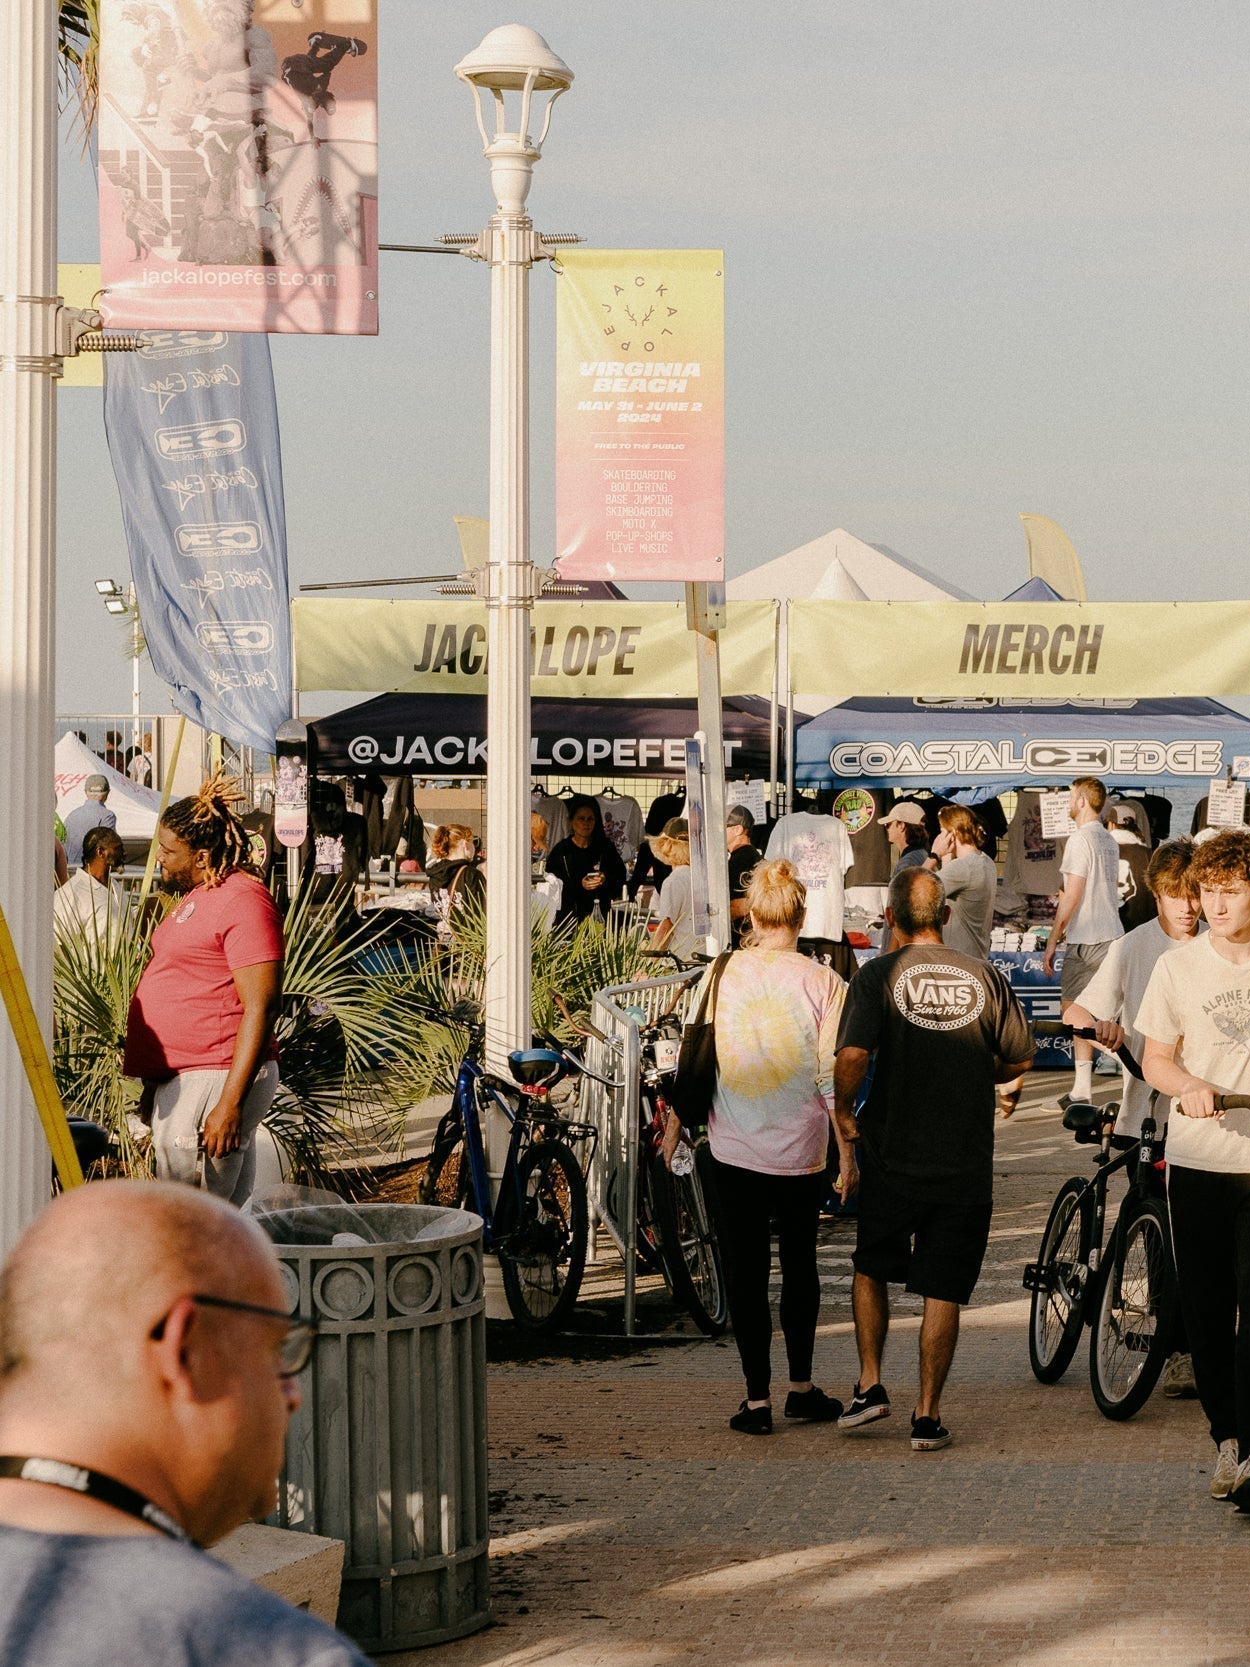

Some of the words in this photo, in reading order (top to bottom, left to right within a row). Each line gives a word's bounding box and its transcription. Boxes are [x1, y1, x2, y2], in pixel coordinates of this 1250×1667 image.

[139, 268, 337, 287] jackalopefest.com
[579, 361, 702, 377] VIRGINIA
[592, 378, 687, 393] BEACH
[578, 401, 612, 411] MAY
[616, 401, 633, 411] 31
[646, 401, 690, 411] JUNE
[691, 401, 703, 411] 2
[617, 413, 662, 423] 2024
[602, 469, 676, 480] SKATEBOARDING
[611, 482, 668, 492] BOULDERING
[605, 495, 628, 505] BASE
[633, 495, 673, 505] JUMPING
[605, 507, 673, 517] SKIMBOARDING
[622, 519, 646, 529] MOTO
[646, 519, 657, 529] X
[605, 531, 674, 541] POP-UP-SHOPS
[611, 543, 635, 553] LIVE
[639, 543, 669, 554] MUSIC
[413, 623, 642, 676] JACLOPE
[958, 623, 1105, 675] MERCH
[347, 735, 743, 767] @JACKLOPEFET
[829, 739, 1027, 777] COASTAL
[1110, 740, 1224, 777] EDGE
[906, 978, 974, 1005] VANS
[1202, 989, 1243, 1015] ALPINE
[912, 1003, 942, 1015] Since
[944, 1005, 967, 1015] 1966
